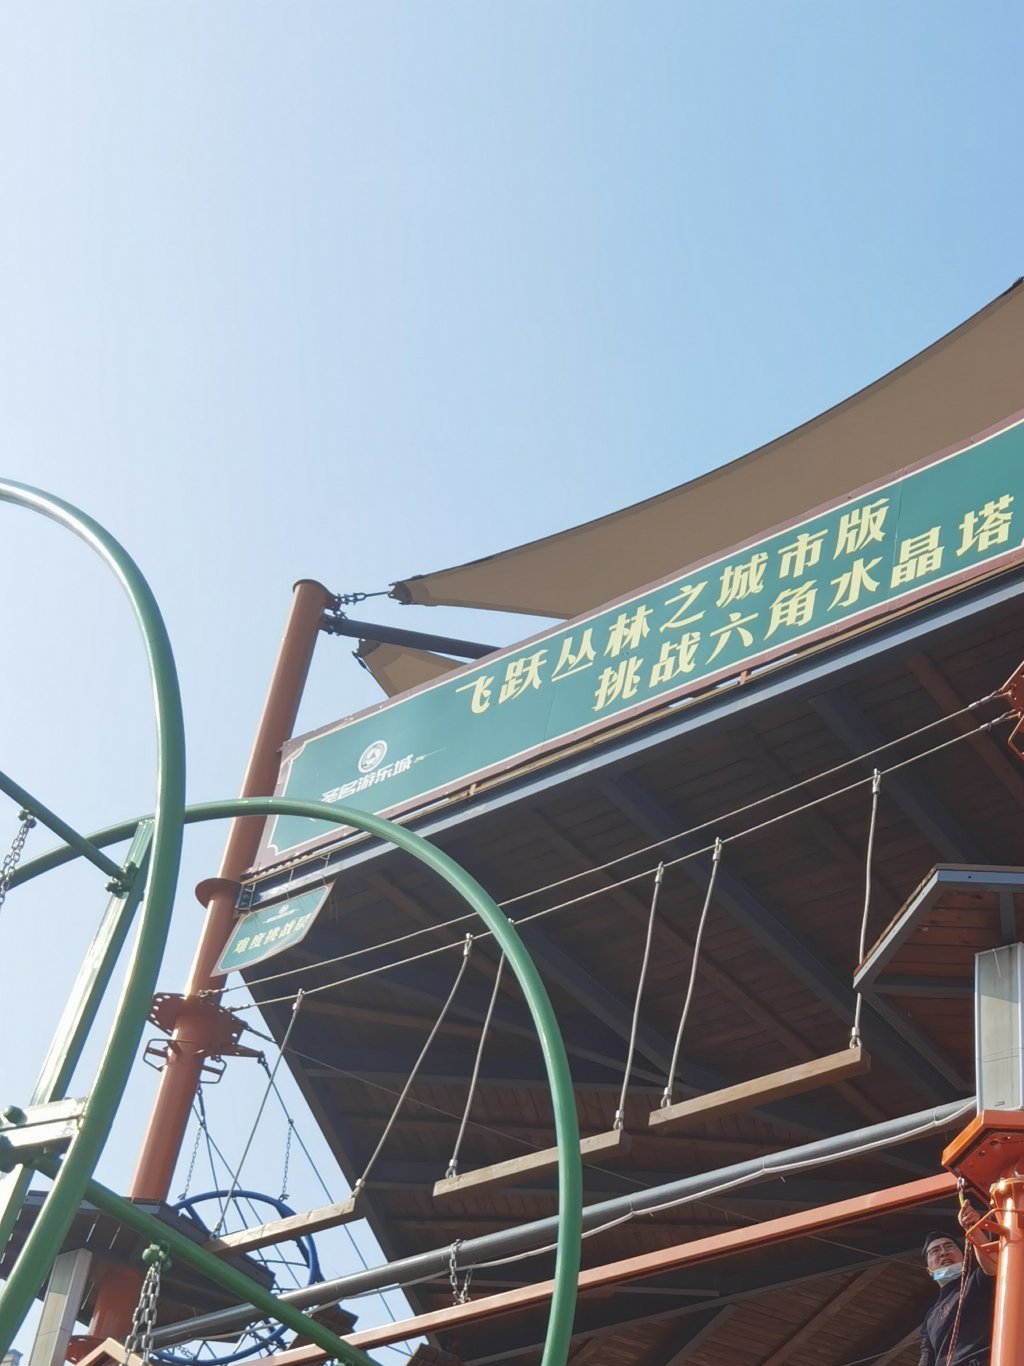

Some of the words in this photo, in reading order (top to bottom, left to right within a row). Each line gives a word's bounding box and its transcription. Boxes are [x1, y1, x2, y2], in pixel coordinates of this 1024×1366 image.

[456, 498, 890, 714] 飞跃丛林之城市版
[592, 494, 1014, 712] 挑战六角水晶塔
[321, 754, 413, 803] 圣名游乐城
